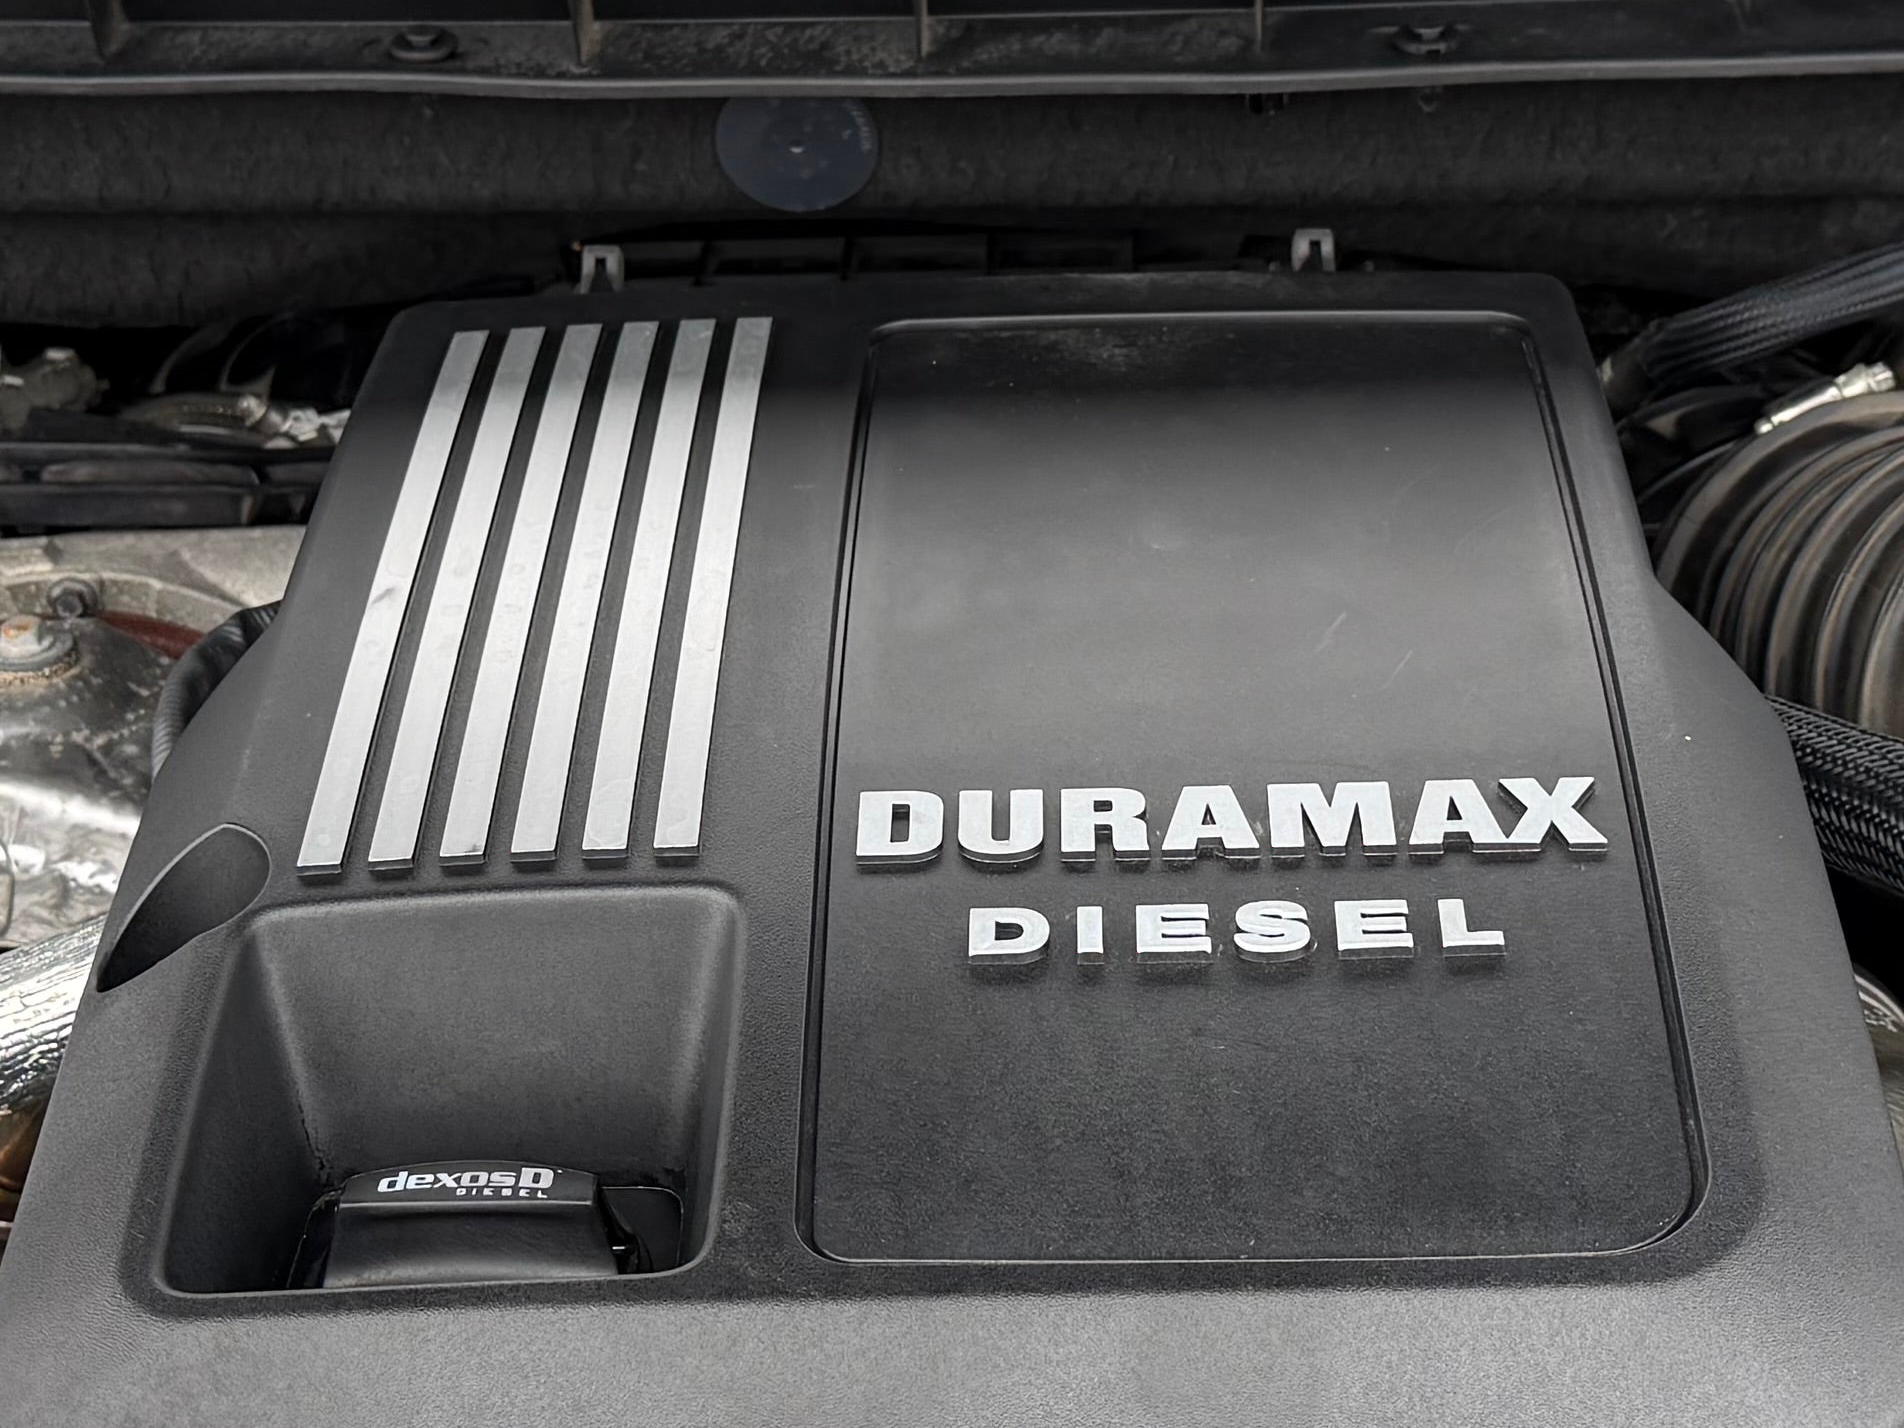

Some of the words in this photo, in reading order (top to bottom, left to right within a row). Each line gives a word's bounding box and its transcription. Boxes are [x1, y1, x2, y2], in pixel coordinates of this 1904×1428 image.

[855, 775, 1608, 865] DURAMAX
[967, 897, 1507, 966] DIESEL
[455, 1186, 549, 1199] DIESEL
